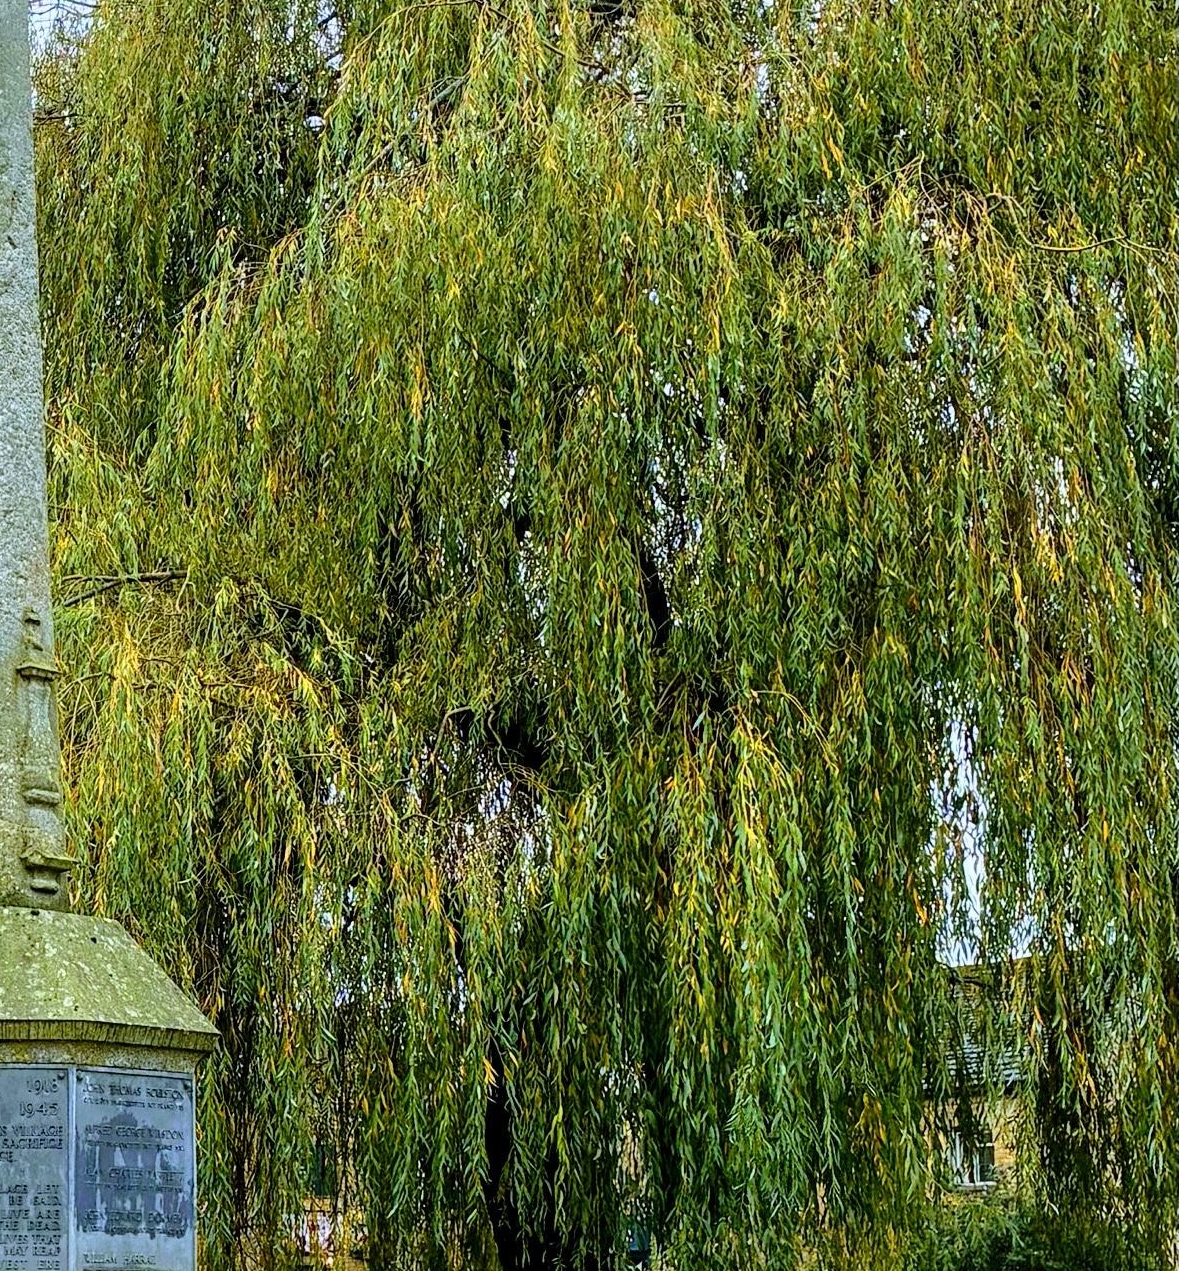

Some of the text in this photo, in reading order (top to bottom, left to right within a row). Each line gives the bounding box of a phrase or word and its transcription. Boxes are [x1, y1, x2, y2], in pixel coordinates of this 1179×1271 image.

[27, 1079, 59, 1095] 1918
[19, 1102, 59, 1118] 1945
[11, 1125, 63, 1137] VILLAGE
[2, 1138, 63, 1150] SACRIFICE
[37, 1184, 60, 1195] LET
[8, 1195, 22, 1206] BE
[1, 1209, 30, 1220] LIVE
[37, 1209, 61, 1220] ARE
[31, 1234, 62, 1245] THAT
[4, 1245, 29, 1257] MAY
[32, 1245, 62, 1257] REAP
[37, 1259, 61, 1271] ERE
